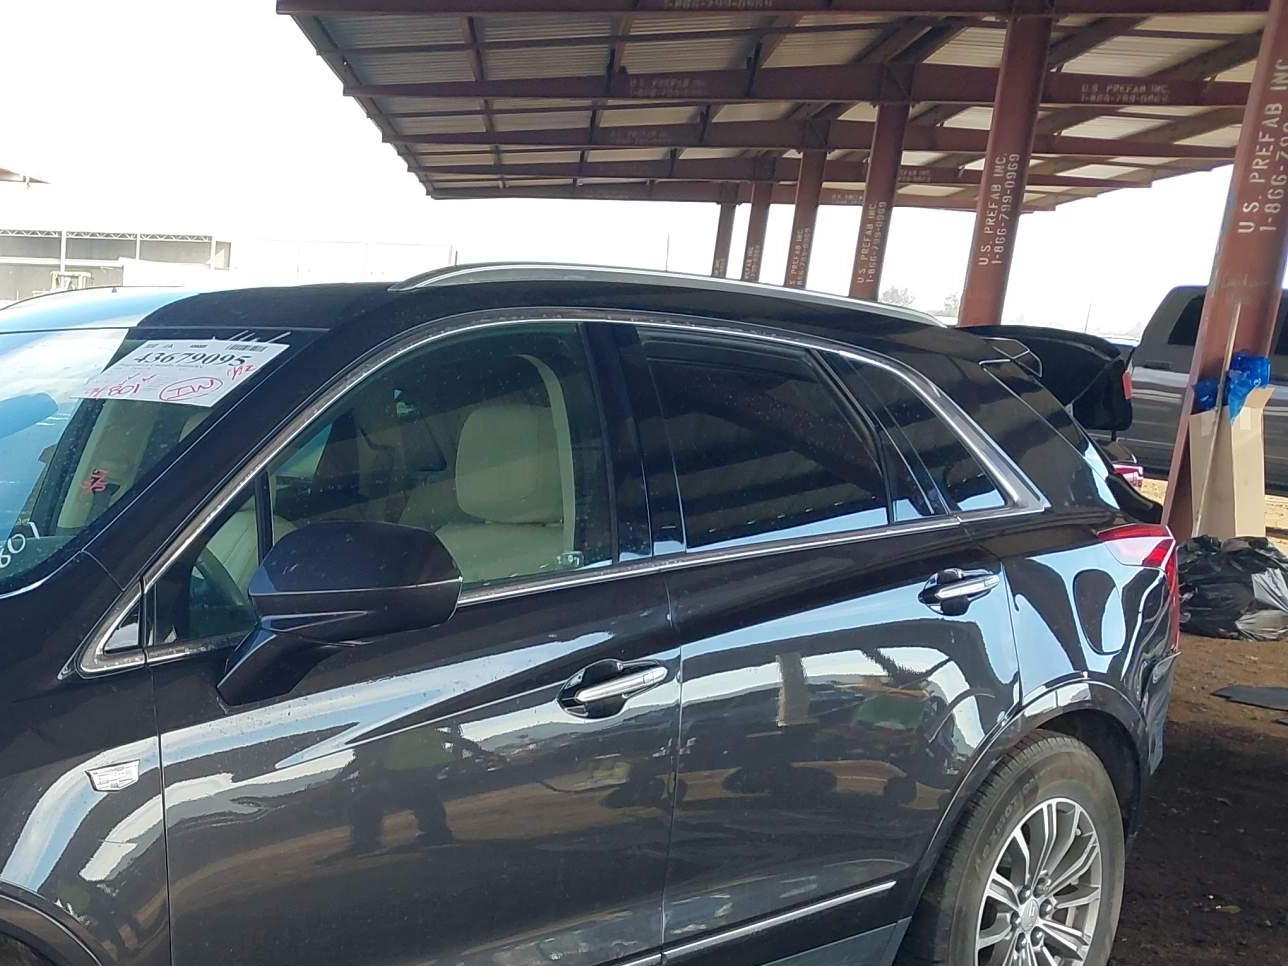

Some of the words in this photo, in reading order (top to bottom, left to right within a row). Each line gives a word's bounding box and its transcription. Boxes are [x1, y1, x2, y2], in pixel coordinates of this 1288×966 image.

[1249, 102, 1283, 183] PREFAB
[984, 184, 1002, 234] PREFAB
[991, 154, 1020, 264] 1-866-799-0969
[978, 241, 994, 265] U.S.
[133, 351, 253, 366] 43679095
